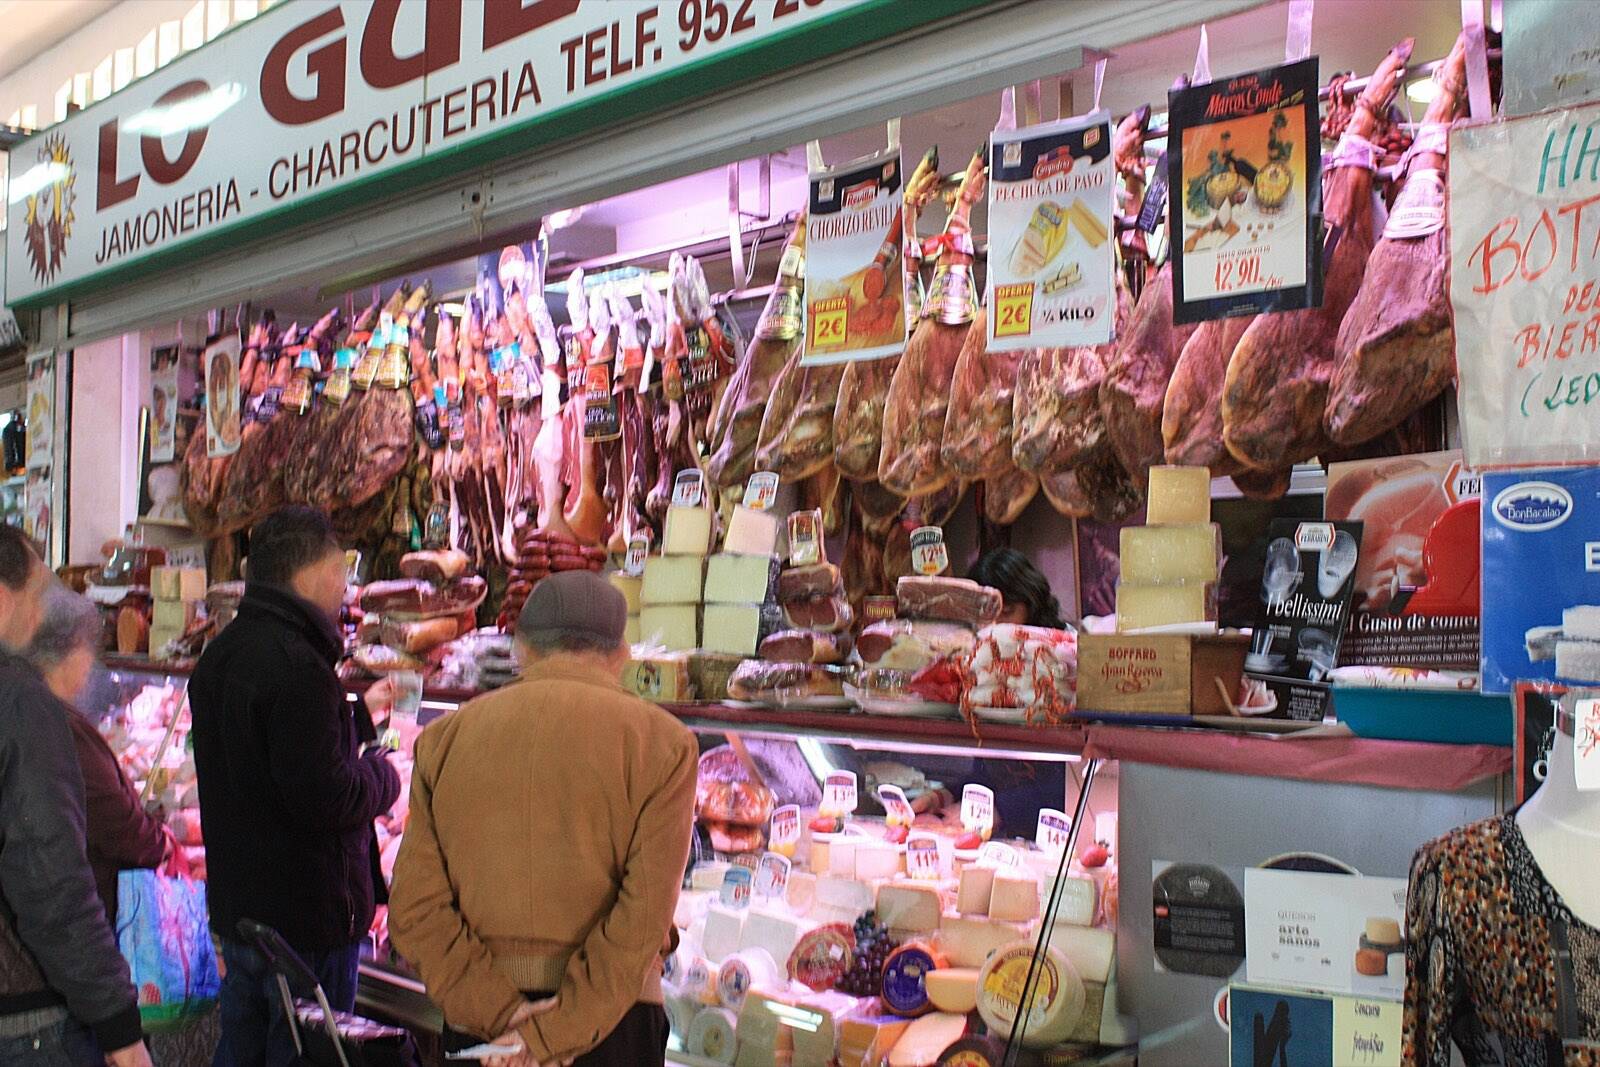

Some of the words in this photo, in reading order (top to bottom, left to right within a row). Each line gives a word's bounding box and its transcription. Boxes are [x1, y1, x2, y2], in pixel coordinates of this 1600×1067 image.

[95, 178, 241, 264] JAMONERIA
[268, 60, 542, 199] CHARCUTERIA
[560, 6, 662, 94] TELF.
[678, 0, 756, 51] 952
[96, 79, 212, 213] LO
[996, 180, 1052, 201] PECHUGA
[1056, 178, 1070, 193] DE
[1075, 172, 1104, 191] PAVO
[810, 214, 861, 241] CHORIZO
[997, 286, 1033, 299] OFERTA
[815, 298, 848, 313] OFERTA
[1001, 303, 1027, 326] 2€
[1060, 306, 1095, 321] KILO
[819, 317, 844, 338] 2€
[1275, 592, 1344, 621] bellissimi
[1359, 612, 1402, 633] Gusto
[1407, 613, 1426, 632] de
[1108, 648, 1157, 661] BOFFARD
